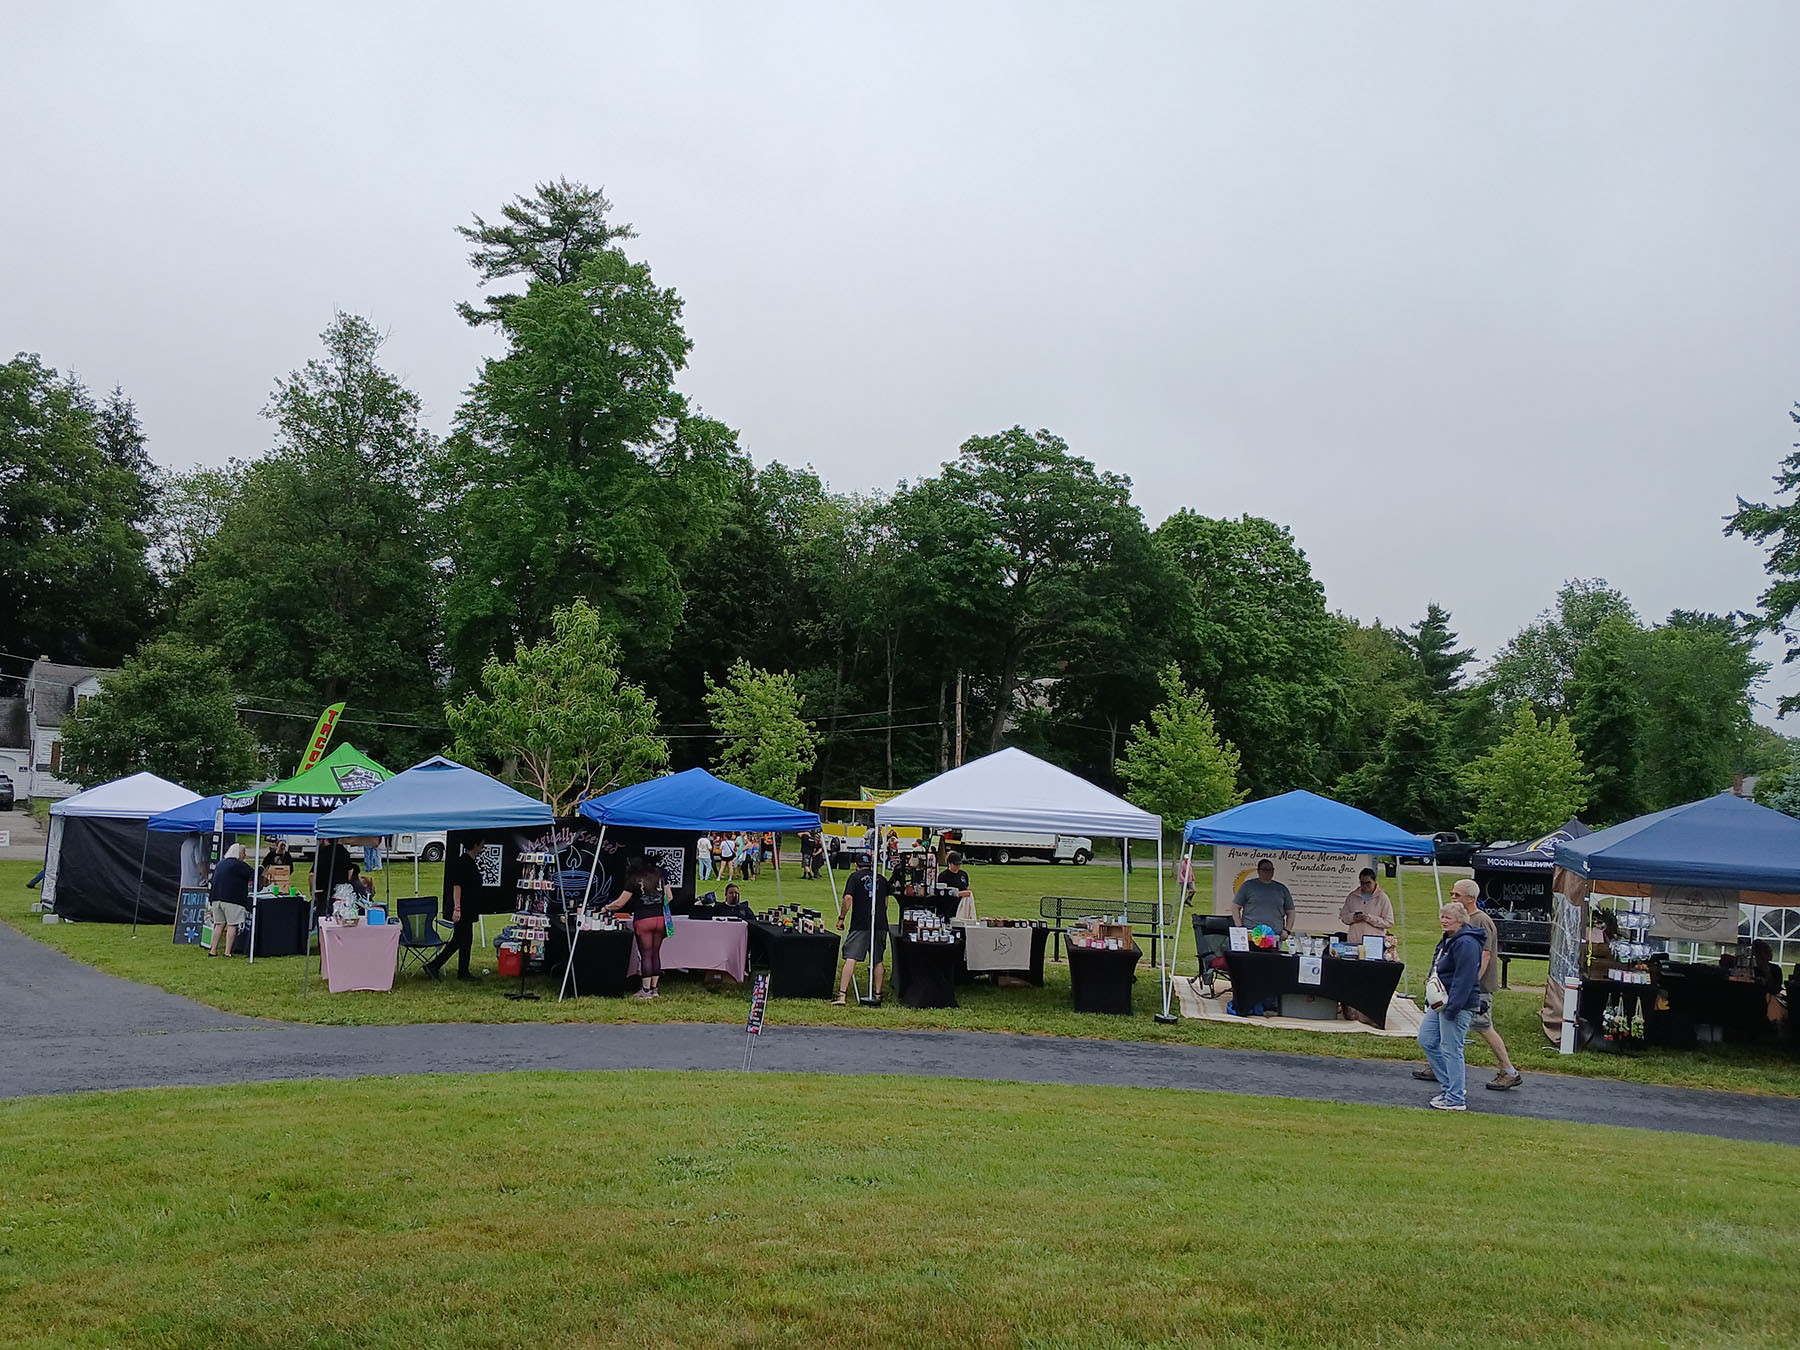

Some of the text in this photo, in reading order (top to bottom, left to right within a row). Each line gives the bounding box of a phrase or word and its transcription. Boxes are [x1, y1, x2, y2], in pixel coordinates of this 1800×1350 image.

[522, 827, 576, 853] Magically
[1250, 849, 1277, 859] James
[1279, 850, 1316, 861] MacLure
[1317, 851, 1357, 862] Memorial
[1290, 861, 1355, 873] Foundation Inc.
[1503, 883, 1530, 895] MOON
[182, 892, 206, 905] TURTL
[181, 908, 206, 923] SALE
